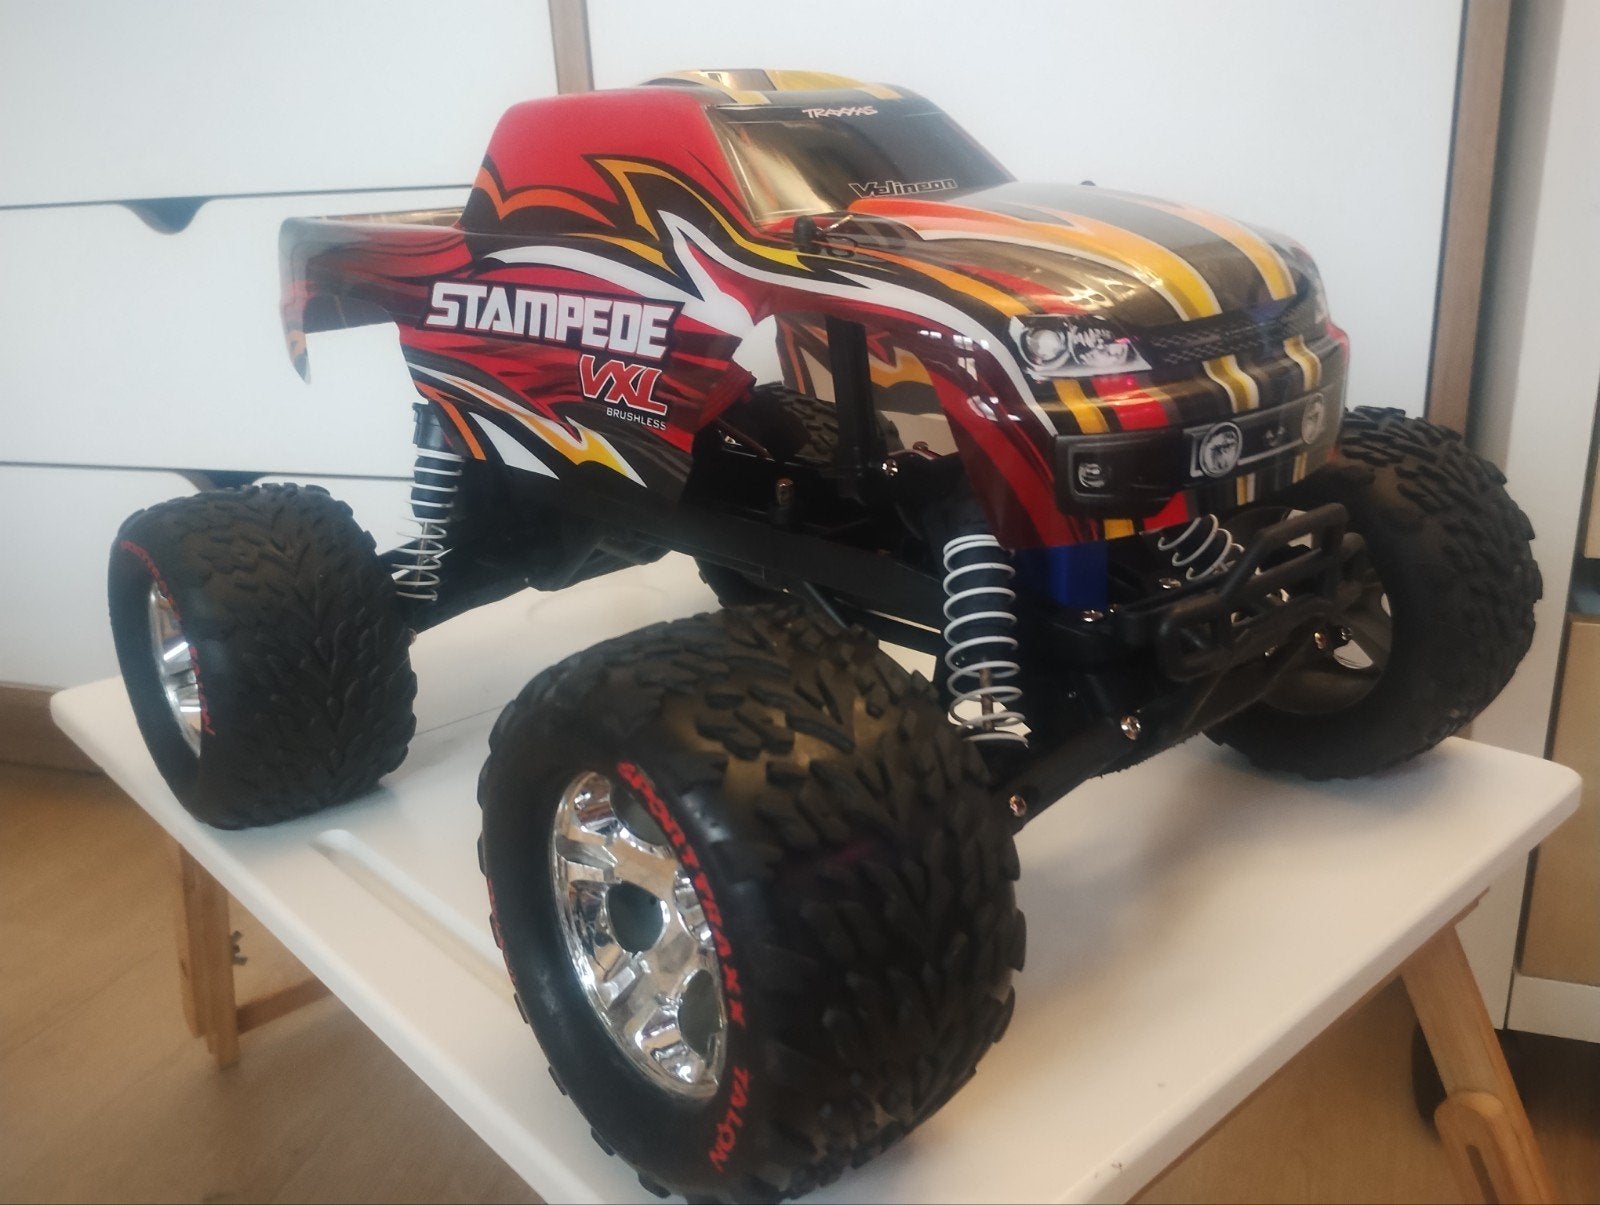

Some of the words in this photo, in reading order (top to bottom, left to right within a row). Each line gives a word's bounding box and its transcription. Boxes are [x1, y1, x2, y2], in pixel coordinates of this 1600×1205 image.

[425, 281, 675, 359] STAMPEDE
[579, 354, 668, 416] VXL
[606, 406, 667, 431] BRUSHLESS
